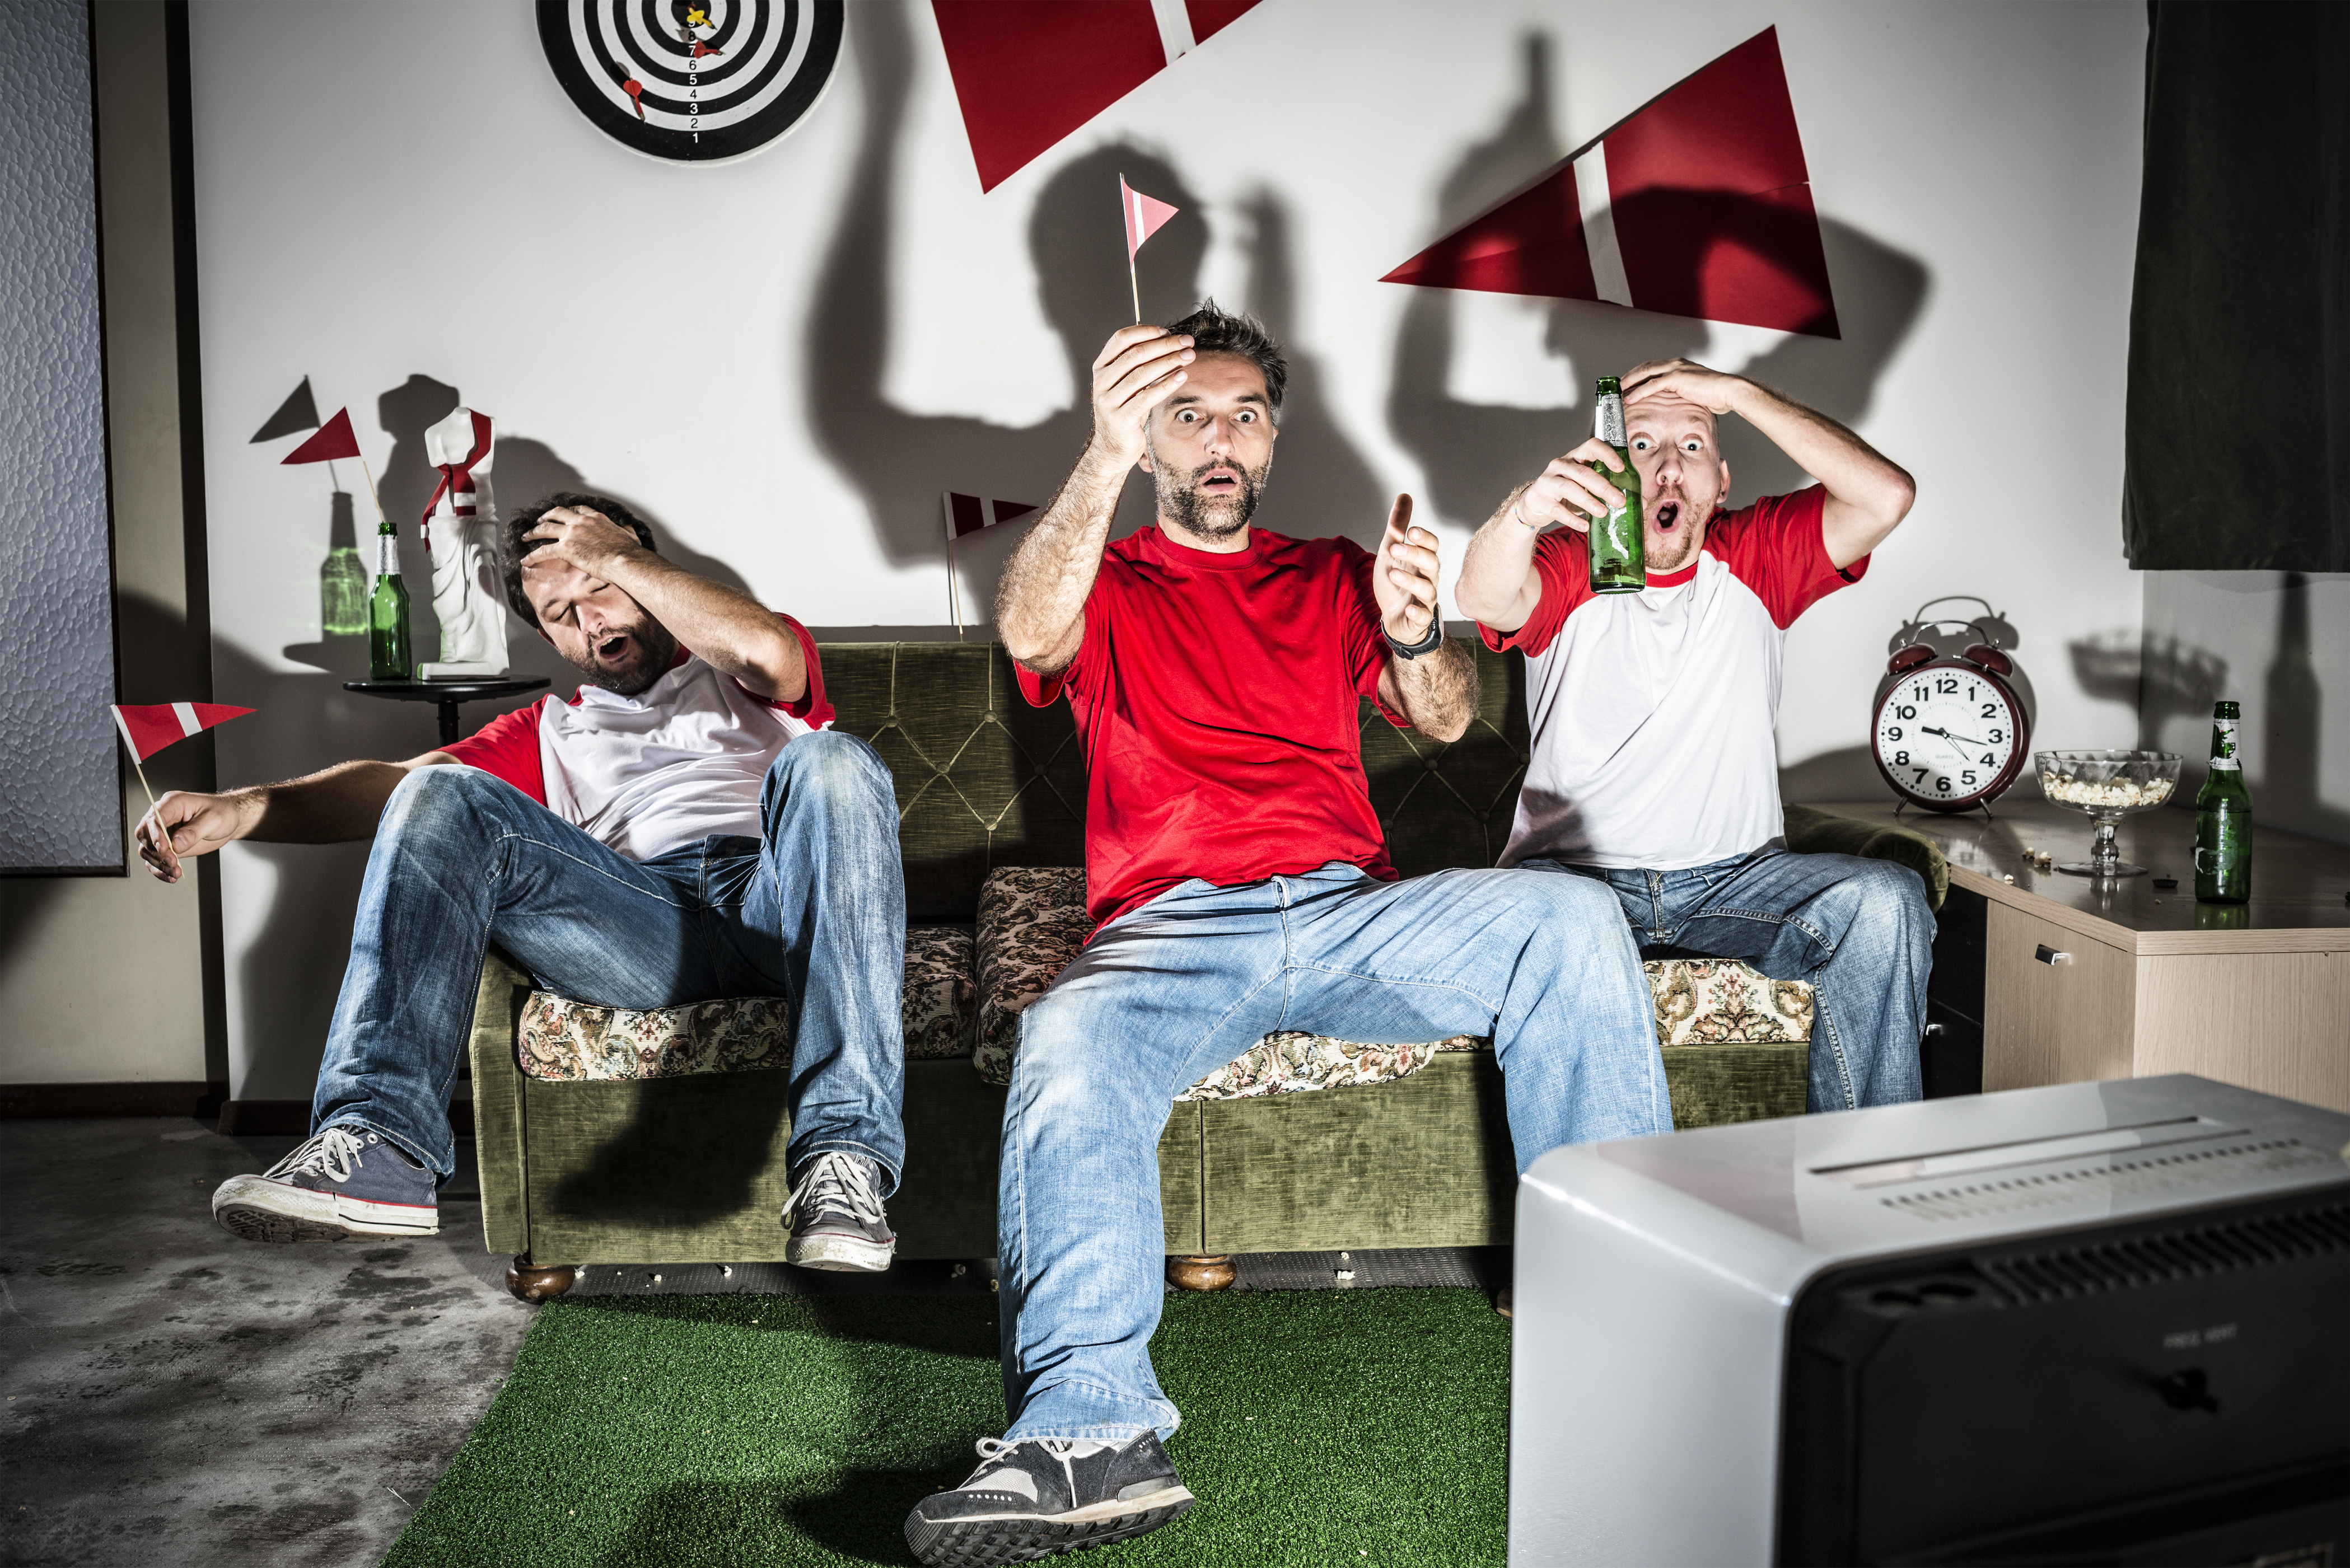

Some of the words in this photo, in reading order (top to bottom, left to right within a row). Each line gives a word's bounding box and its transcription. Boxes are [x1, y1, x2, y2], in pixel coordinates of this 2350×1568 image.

[688, 31, 695, 41] 8
[688, 45, 696, 56] 7
[689, 60, 697, 70] 6
[689, 74, 697, 85] 5
[690, 89, 697, 99] 4
[690, 103, 698, 114] 3
[691, 118, 698, 129] 2
[693, 132, 698, 143] 1
[1914, 686, 1929, 701] 11
[1936, 679, 1958, 694] 12
[1968, 686, 1975, 701] 1
[1895, 705, 1917, 719] 10
[1981, 704, 1997, 718] 2
[1888, 727, 1903, 741] 9
[1988, 729, 2003, 743] 3
[1895, 751, 1909, 766] 8
[1979, 752, 1996, 767] 4
[1912, 768, 1929, 784] 7
[1961, 770, 1977, 785] 5
[1936, 776, 1951, 792] 6
